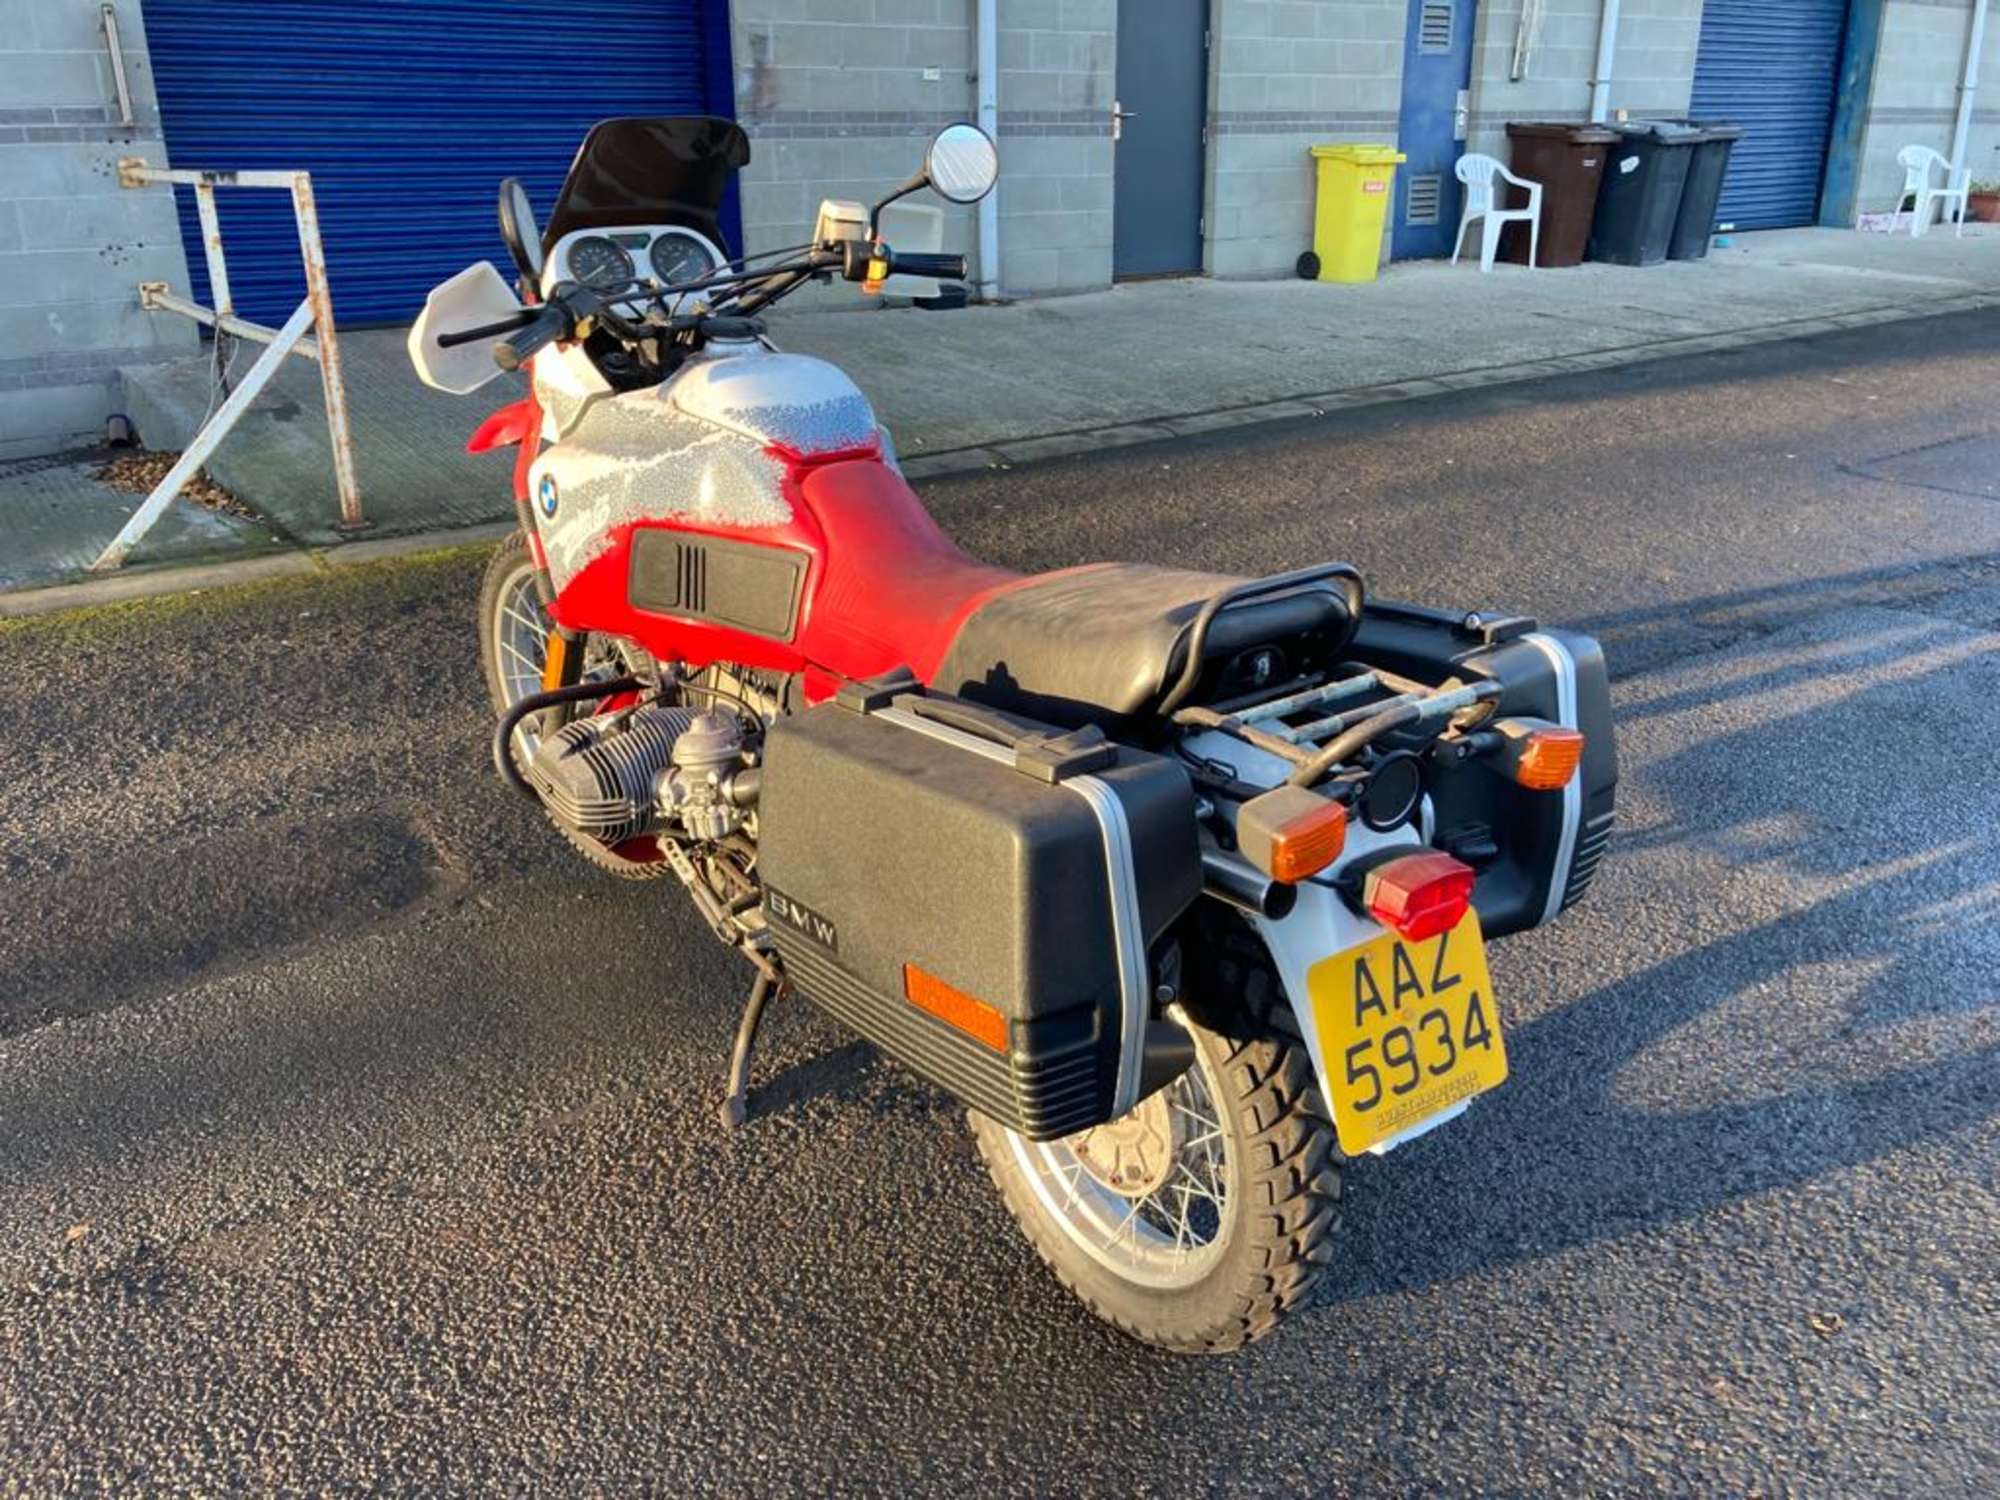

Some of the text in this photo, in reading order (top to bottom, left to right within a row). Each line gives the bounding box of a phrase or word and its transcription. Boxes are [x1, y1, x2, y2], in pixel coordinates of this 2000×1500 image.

[769, 891, 835, 945] BMW
[1354, 932, 1462, 1027] AAZ
[1345, 990, 1493, 1113] 5934
